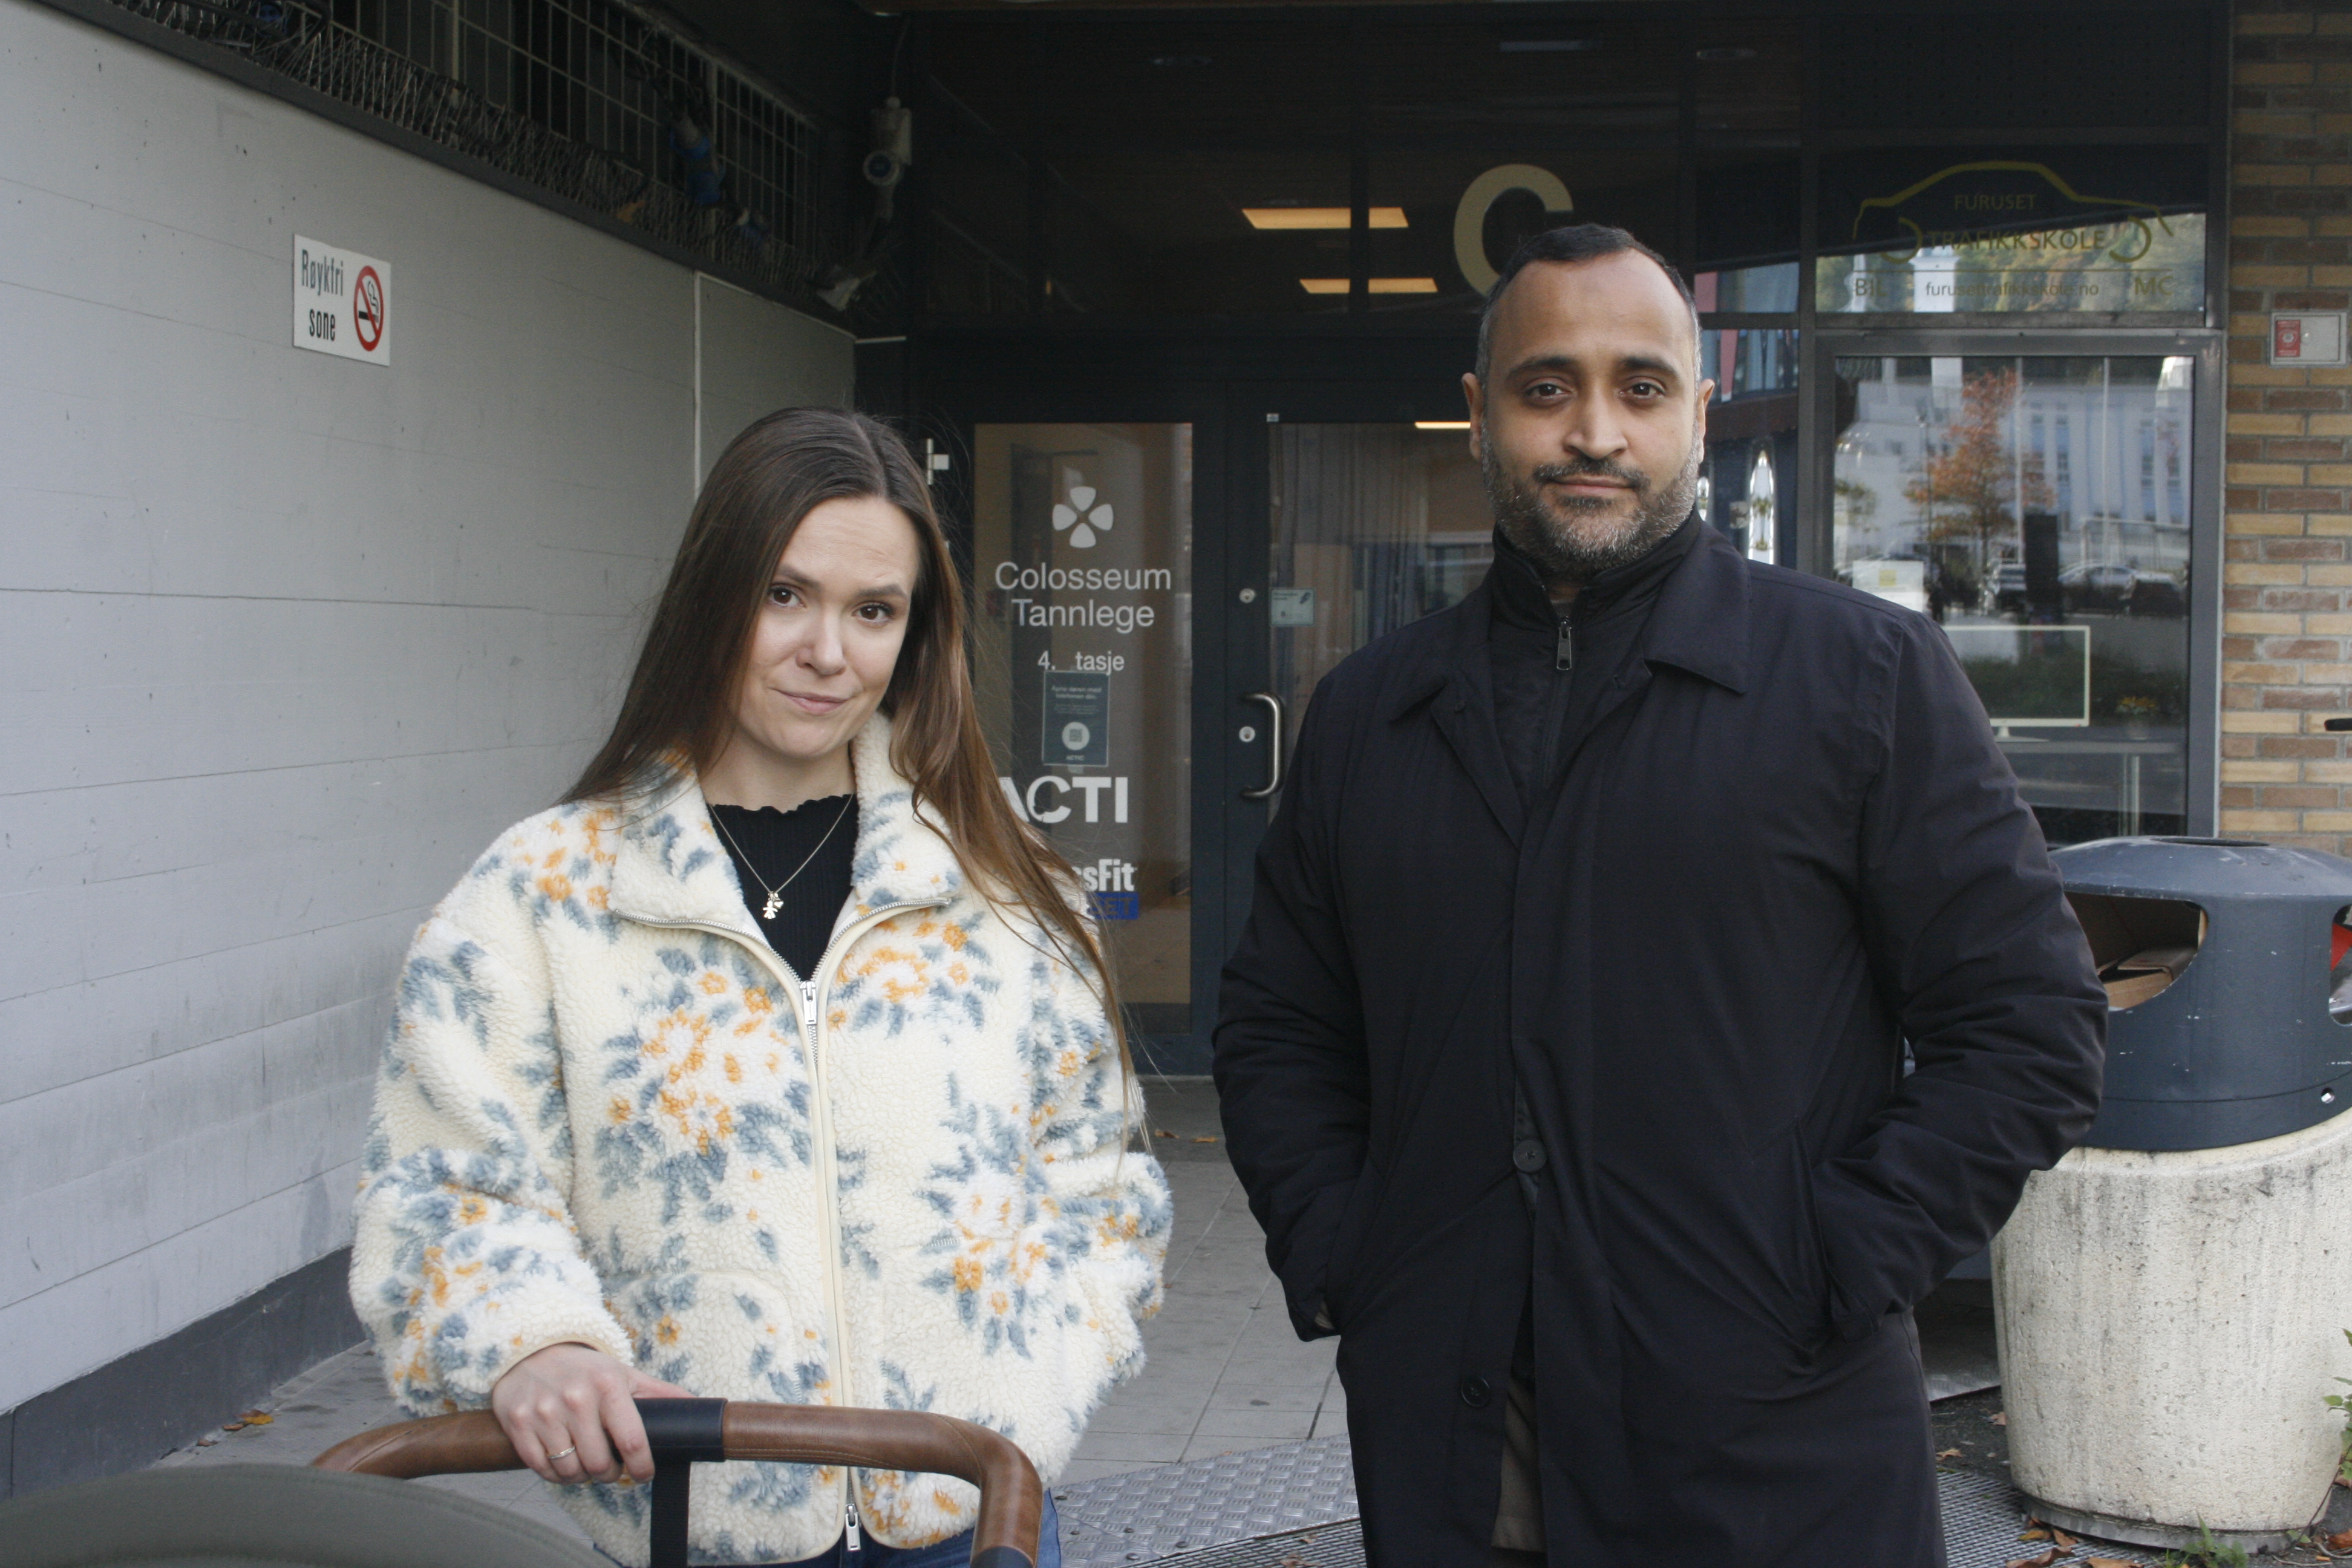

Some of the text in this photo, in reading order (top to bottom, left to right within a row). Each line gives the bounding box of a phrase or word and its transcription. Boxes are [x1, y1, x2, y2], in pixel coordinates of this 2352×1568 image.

[1955, 194, 2038, 210] FURUSET
[1453, 163, 1573, 297] C
[1928, 230, 2105, 250] TRAFIKKSKOLE
[301, 249, 344, 296] Røykfri
[2134, 275, 2174, 296] MC
[1855, 278, 1888, 296] BIL
[309, 309, 336, 341] sone
[995, 561, 1171, 590] Colosseum
[1011, 598, 1155, 634] Tannlege
[1037, 650, 1125, 676] 4. tasje
